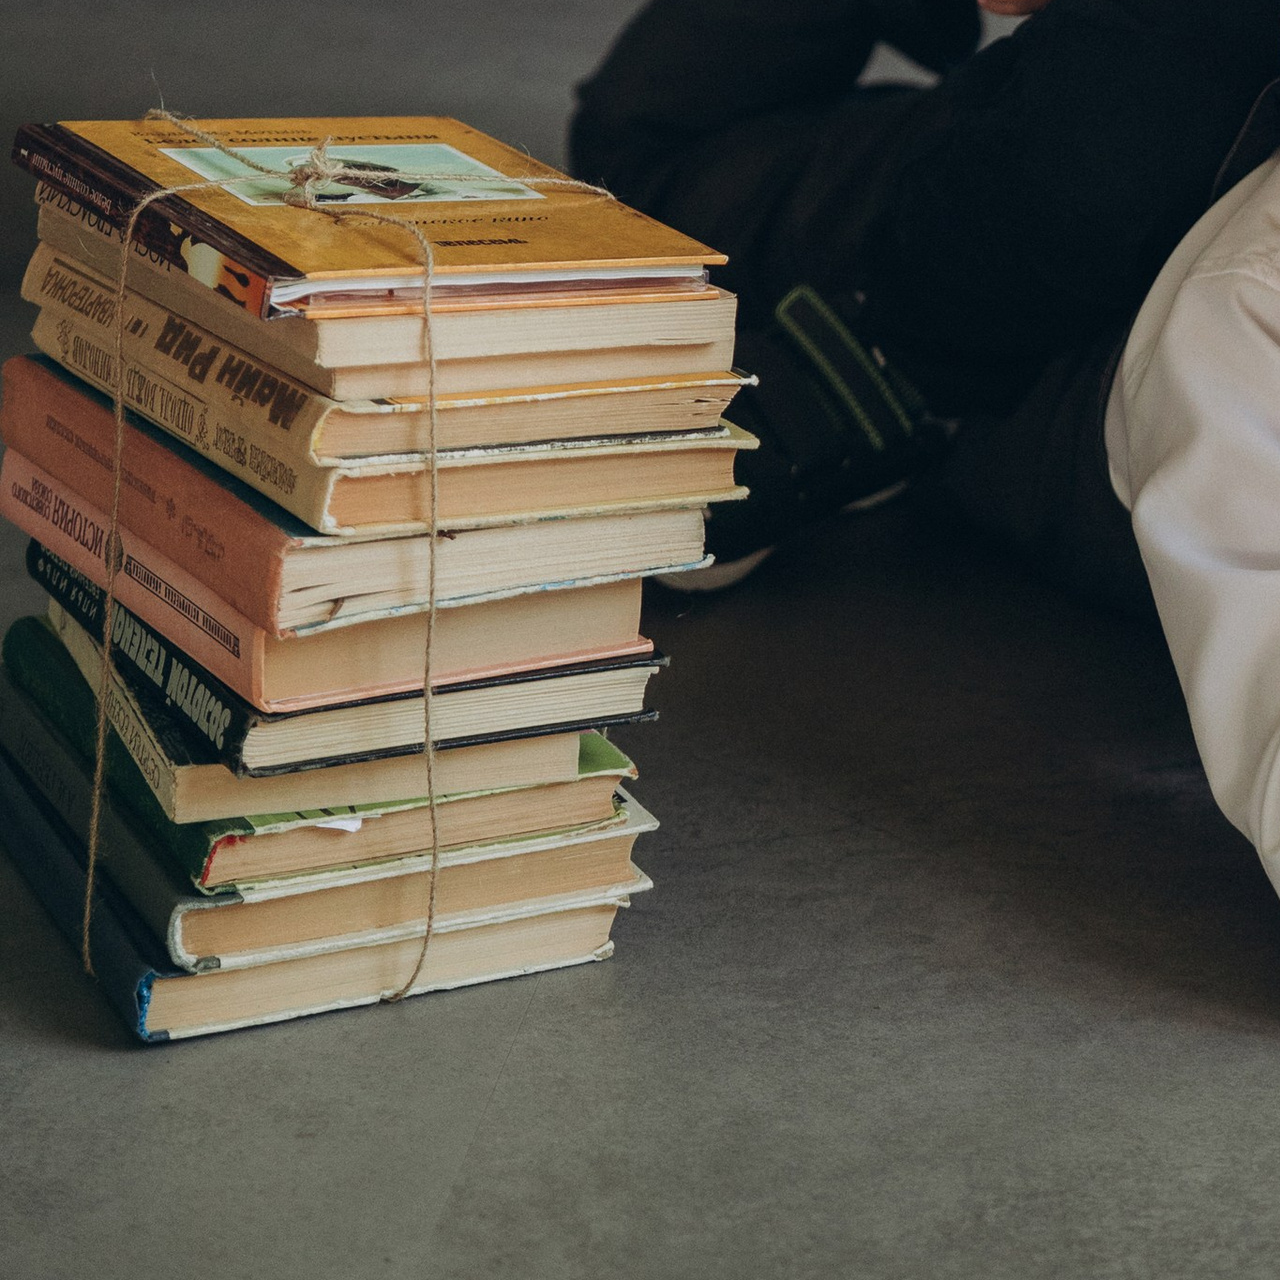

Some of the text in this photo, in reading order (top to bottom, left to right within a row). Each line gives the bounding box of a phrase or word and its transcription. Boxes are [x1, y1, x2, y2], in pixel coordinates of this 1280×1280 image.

[63, 171, 90, 197] солнце
[89, 188, 113, 215] Белое
[154, 314, 308, 430] Майн Рид
[51, 494, 104, 560] ИСТОРИЯ
[37, 557, 98, 621] ИЛЬЯ ИЛЬФ
[165, 657, 232, 751] ЗОЛОТОЙ
